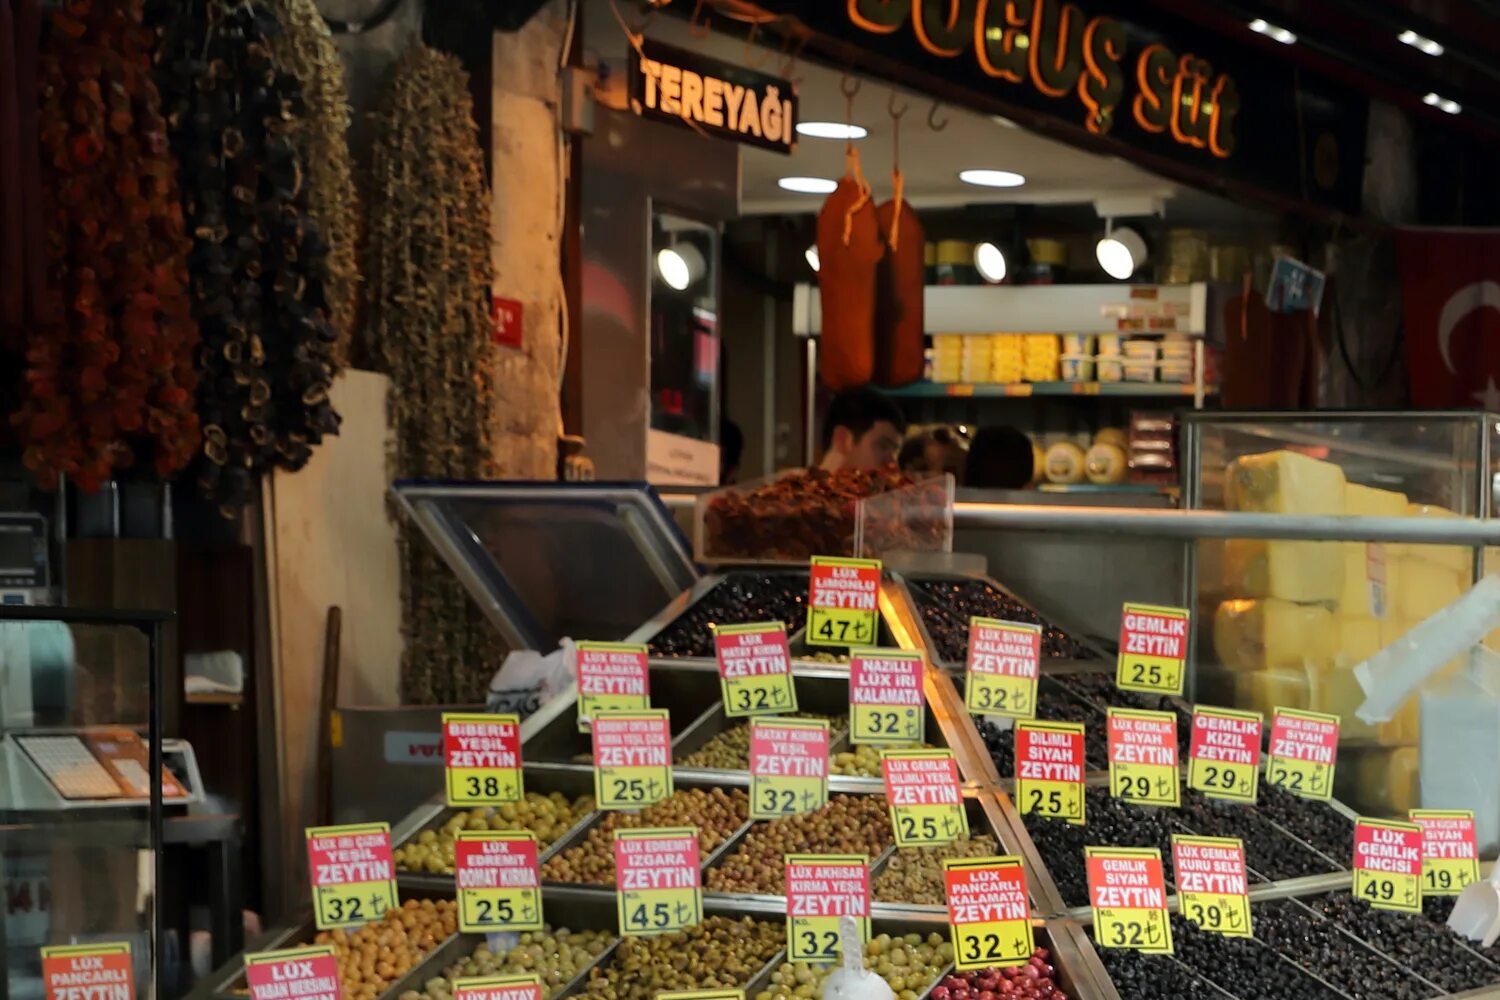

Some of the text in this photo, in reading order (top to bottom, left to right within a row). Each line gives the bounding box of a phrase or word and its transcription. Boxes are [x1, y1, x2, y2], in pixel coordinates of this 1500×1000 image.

[640, 57, 793, 145] TEREYAĞI
[820, 619, 850, 640] 47
[1132, 664, 1161, 685] 25
[737, 688, 769, 711] 32
[854, 687, 921, 705] KALAMATA
[977, 687, 1007, 708] 32
[868, 712, 899, 733] 32
[466, 776, 498, 797] 38
[1119, 776, 1150, 798] 29
[1203, 766, 1236, 789] 29
[1275, 769, 1303, 790] 22
[613, 779, 645, 801] 25
[762, 789, 796, 812] 32
[1030, 789, 1061, 813] 25
[901, 817, 937, 839] 25
[1178, 859, 1242, 873] KURU SELE
[951, 880, 1021, 895] PANCARLI
[1426, 869, 1451, 888] 19
[950, 891, 1025, 906] KALAMATA
[1095, 886, 1163, 907] ZEYTiN
[1364, 880, 1394, 900] 49
[328, 897, 363, 920] 32
[476, 899, 514, 922] 25
[632, 903, 669, 927] 45
[953, 902, 1027, 923] ZEYTiN
[1191, 904, 1221, 928] 39
[802, 931, 839, 955] 32
[1111, 921, 1144, 945] 32
[965, 933, 1002, 959] 32
